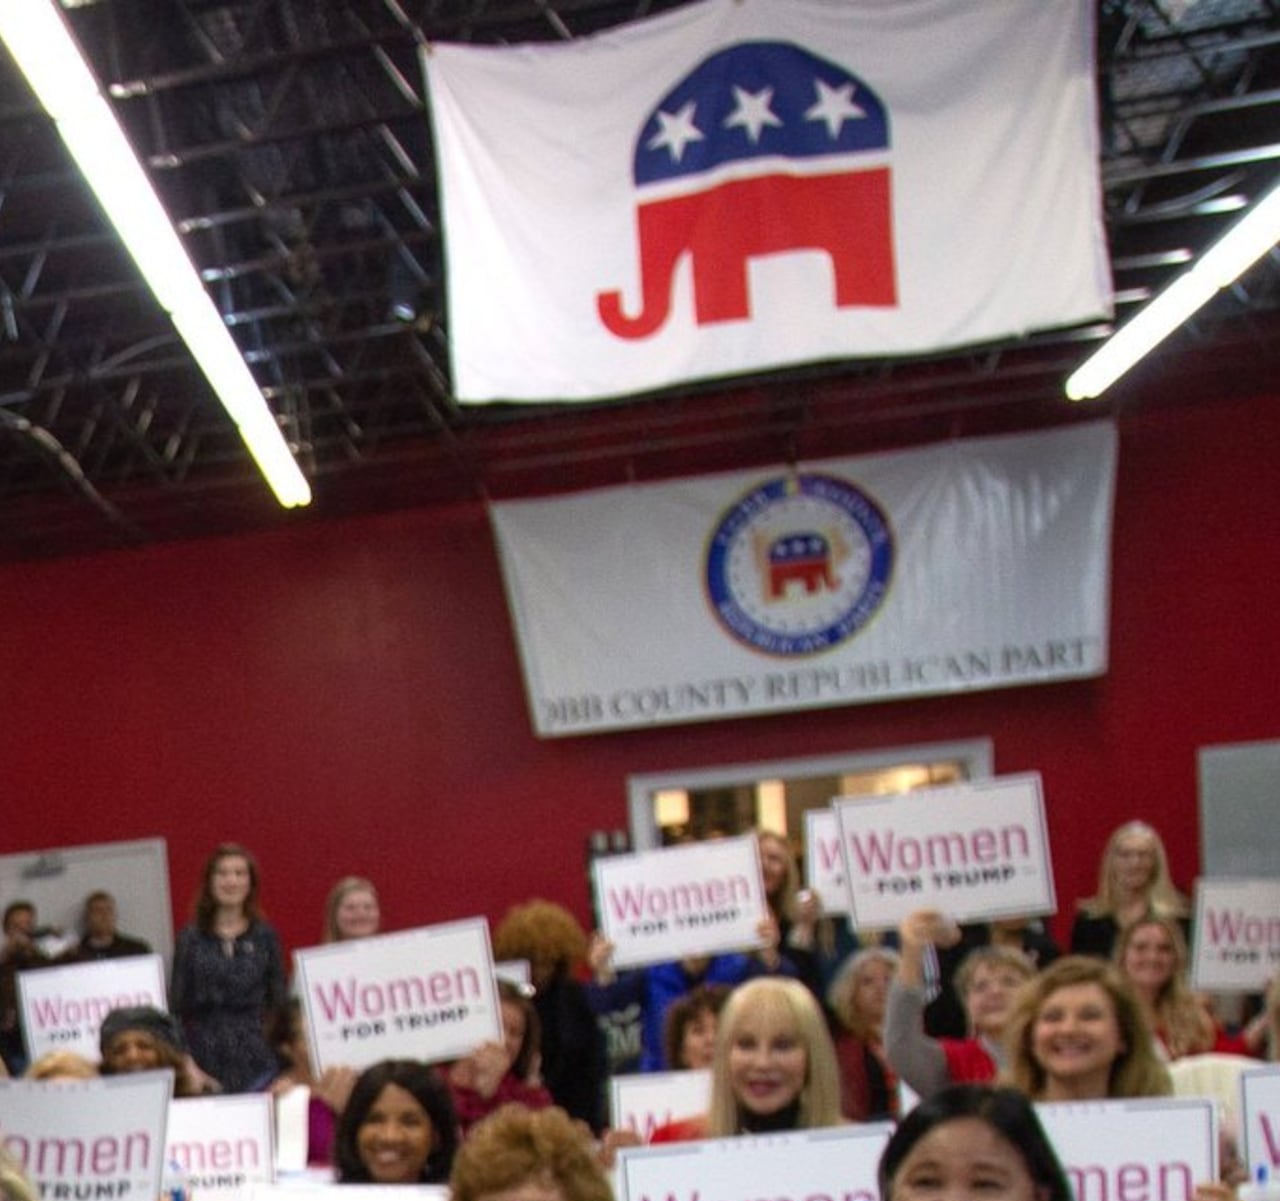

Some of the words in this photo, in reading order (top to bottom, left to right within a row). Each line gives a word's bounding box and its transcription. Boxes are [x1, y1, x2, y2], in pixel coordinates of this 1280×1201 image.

[763, 651, 991, 702] REPUBLICAN
[851, 822, 1031, 876] Women
[877, 876, 923, 894] FOR
[932, 865, 1017, 890] TRUMP
[609, 873, 750, 922] Women
[631, 921, 669, 937] FOR
[676, 909, 740, 931] TRUMP
[315, 964, 481, 1024] Women
[342, 1019, 387, 1041] FOR
[394, 1006, 470, 1033] TRUMP
[169, 1135, 259, 1170] men
[189, 1174, 246, 1189] RUMP
